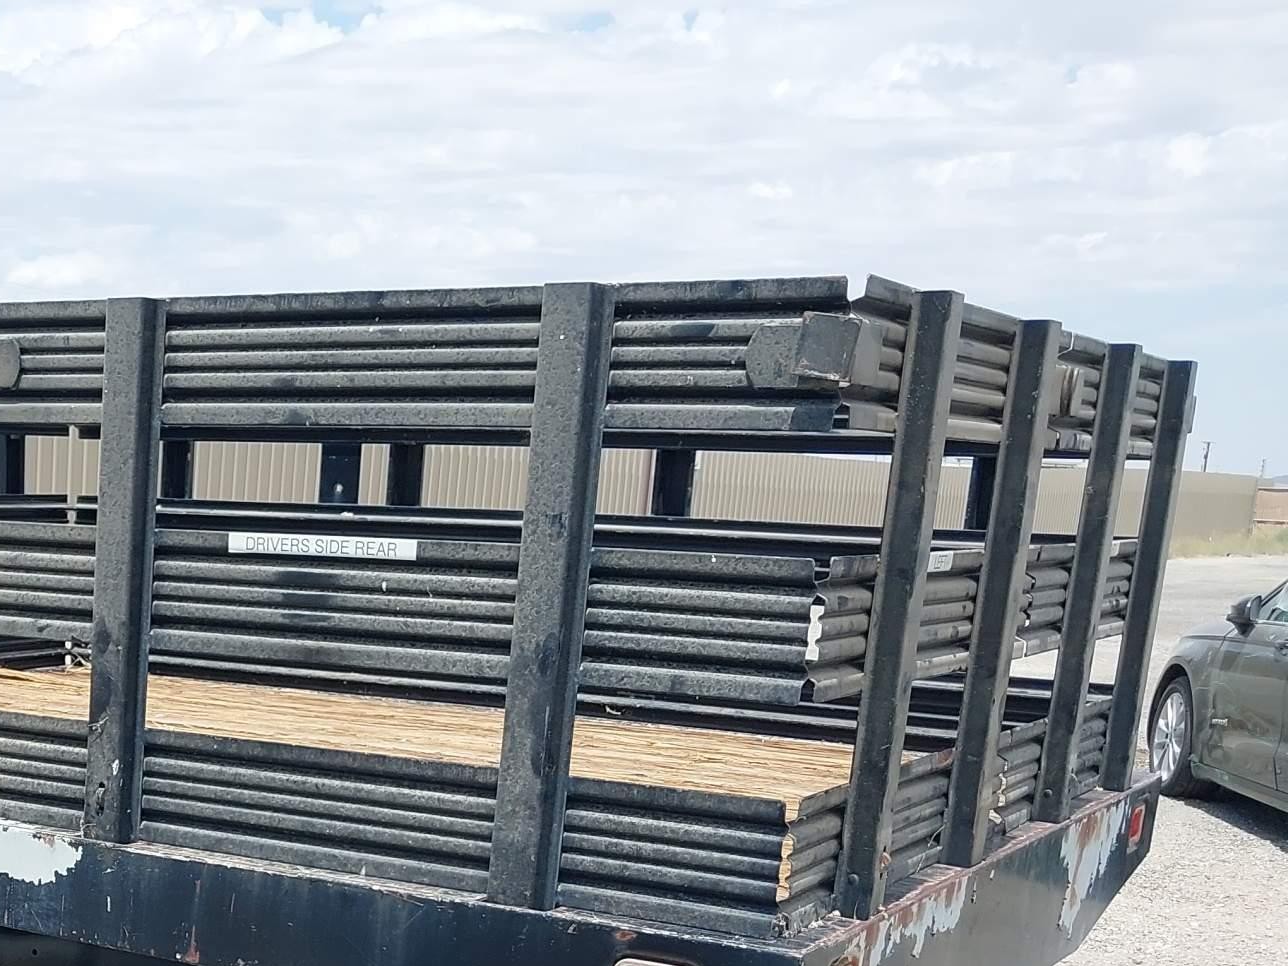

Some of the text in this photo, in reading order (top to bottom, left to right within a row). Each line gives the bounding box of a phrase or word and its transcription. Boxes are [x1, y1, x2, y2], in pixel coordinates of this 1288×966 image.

[245, 536, 398, 558] DRIVERS SIDE REAR
